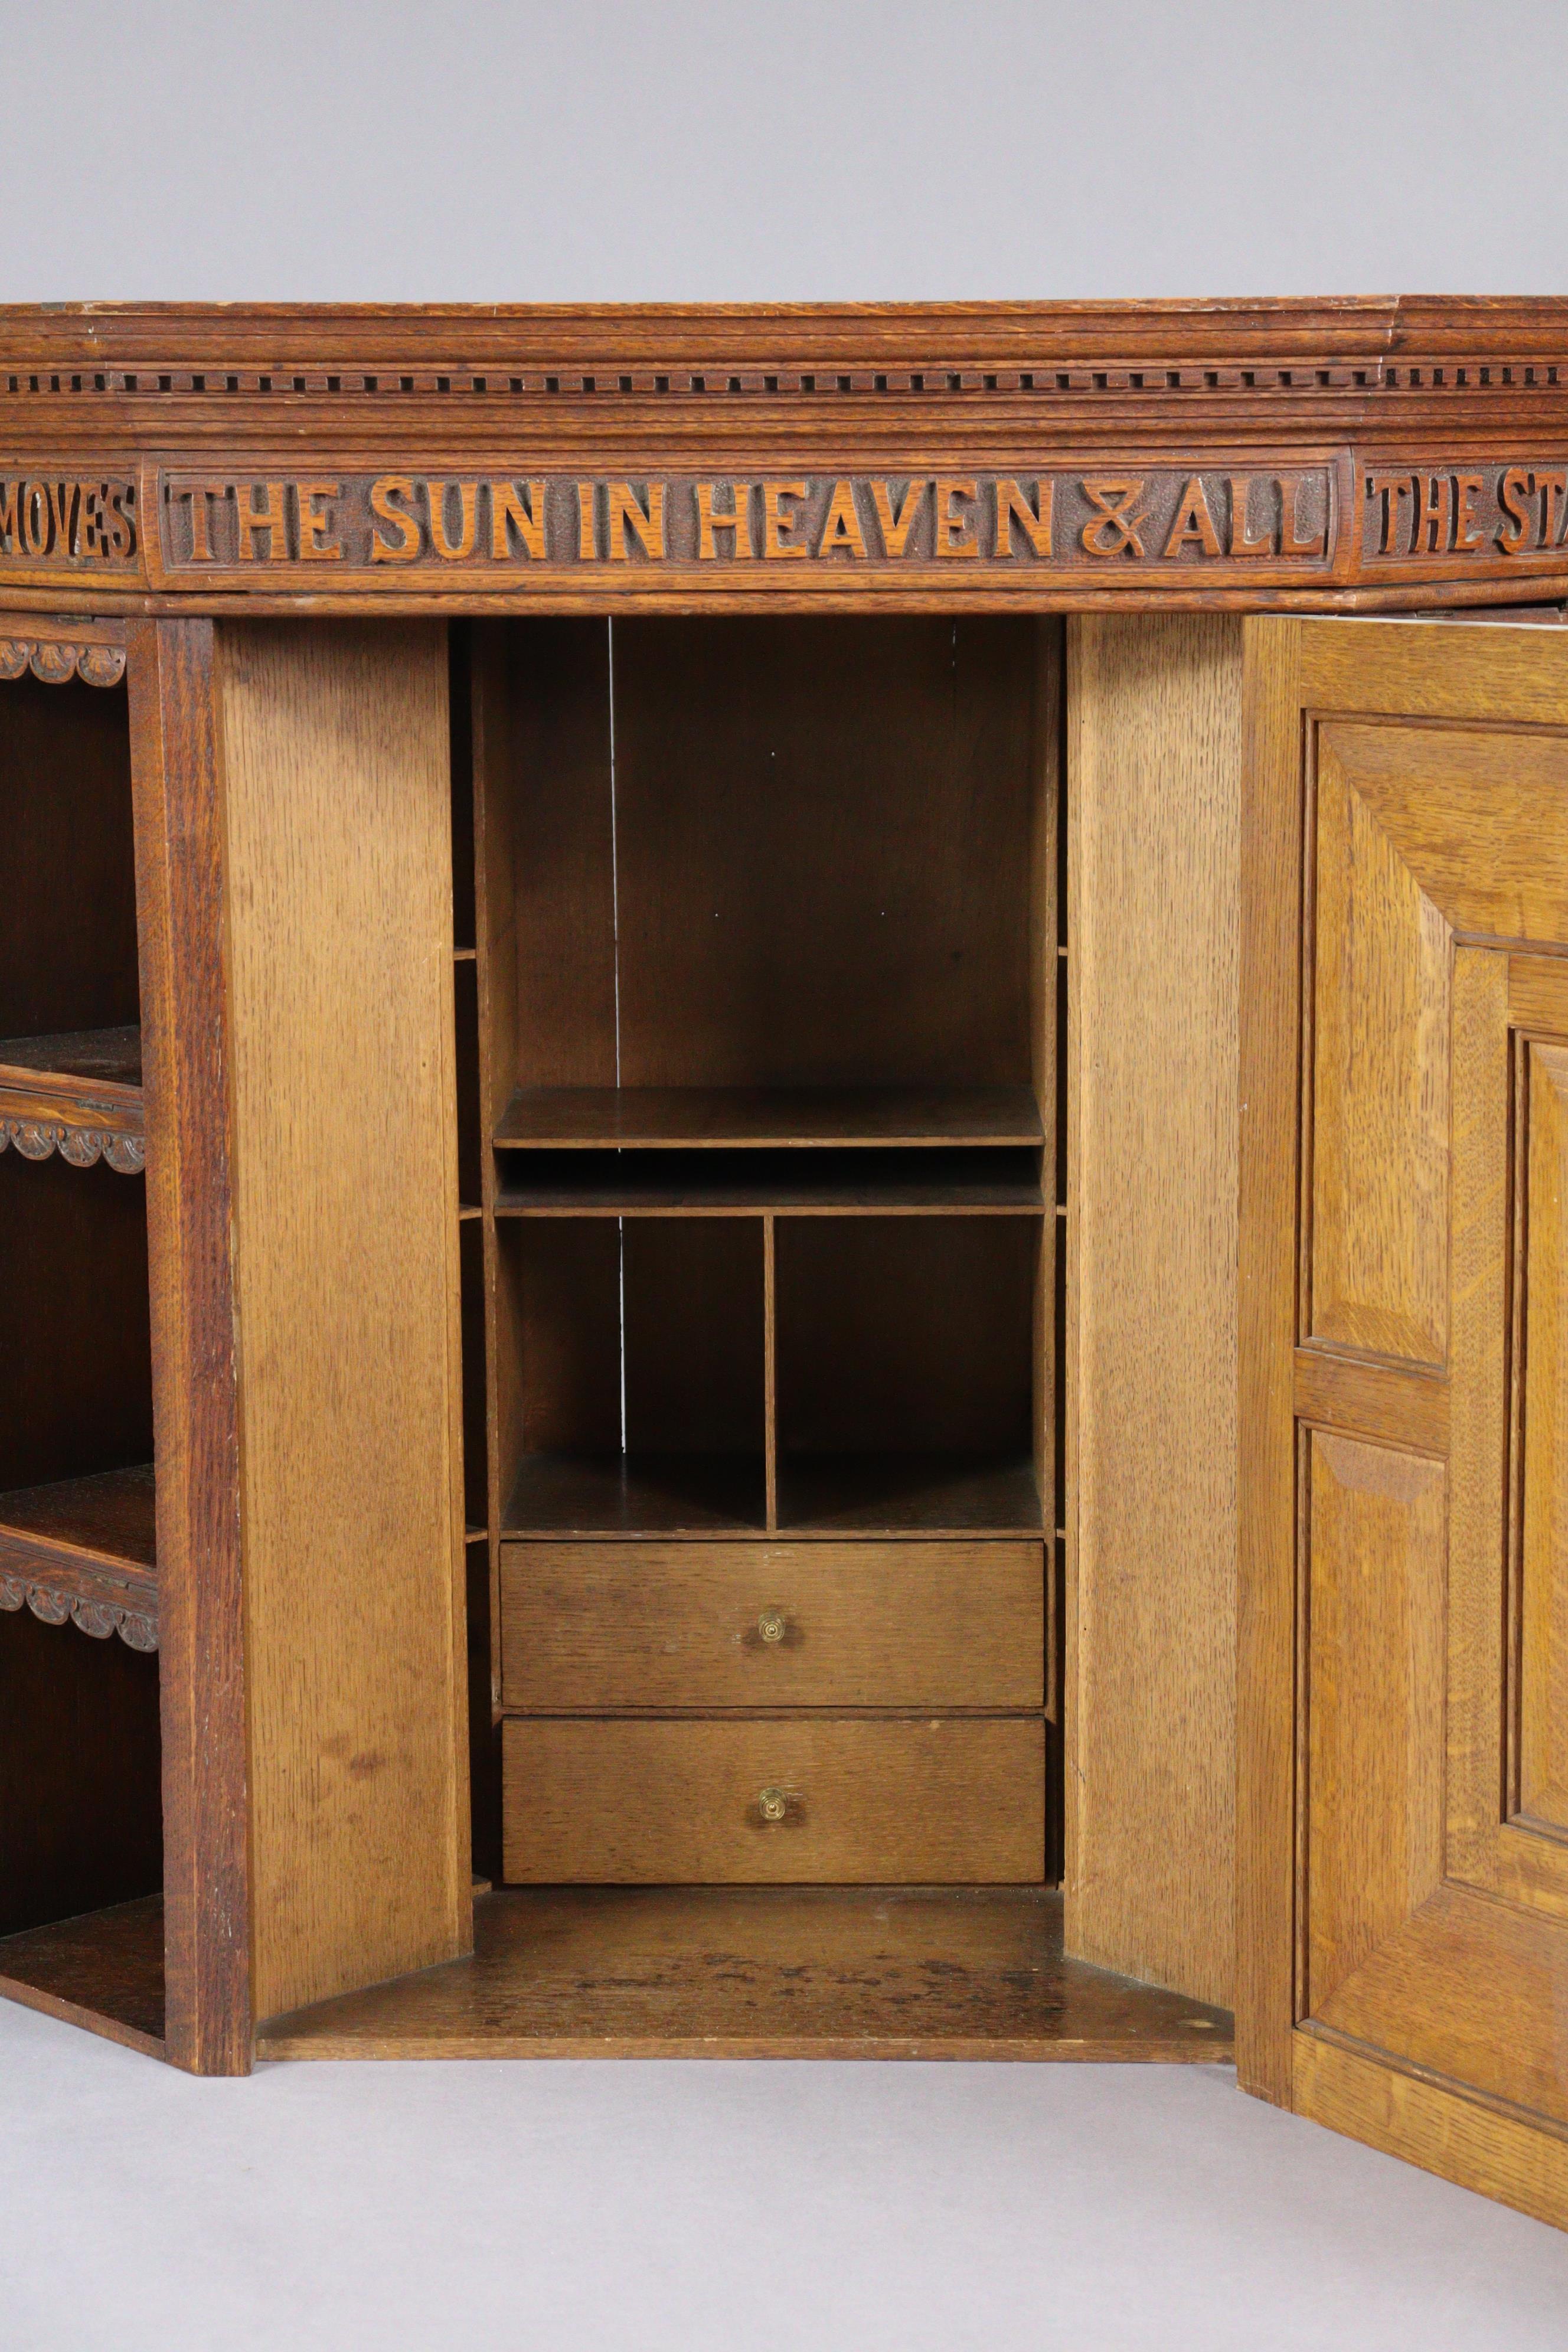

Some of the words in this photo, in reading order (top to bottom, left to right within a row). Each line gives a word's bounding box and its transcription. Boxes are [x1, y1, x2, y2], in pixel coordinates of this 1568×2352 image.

[169, 482, 343, 560] THE
[371, 475, 545, 562] SUN
[578, 482, 664, 558] IN
[697, 481, 1054, 558] HEAVEN
[1082, 478, 1149, 557] &
[1163, 477, 1327, 556] ALL
[1372, 475, 1484, 553] THE
[1495, 468, 1568, 554] ST
